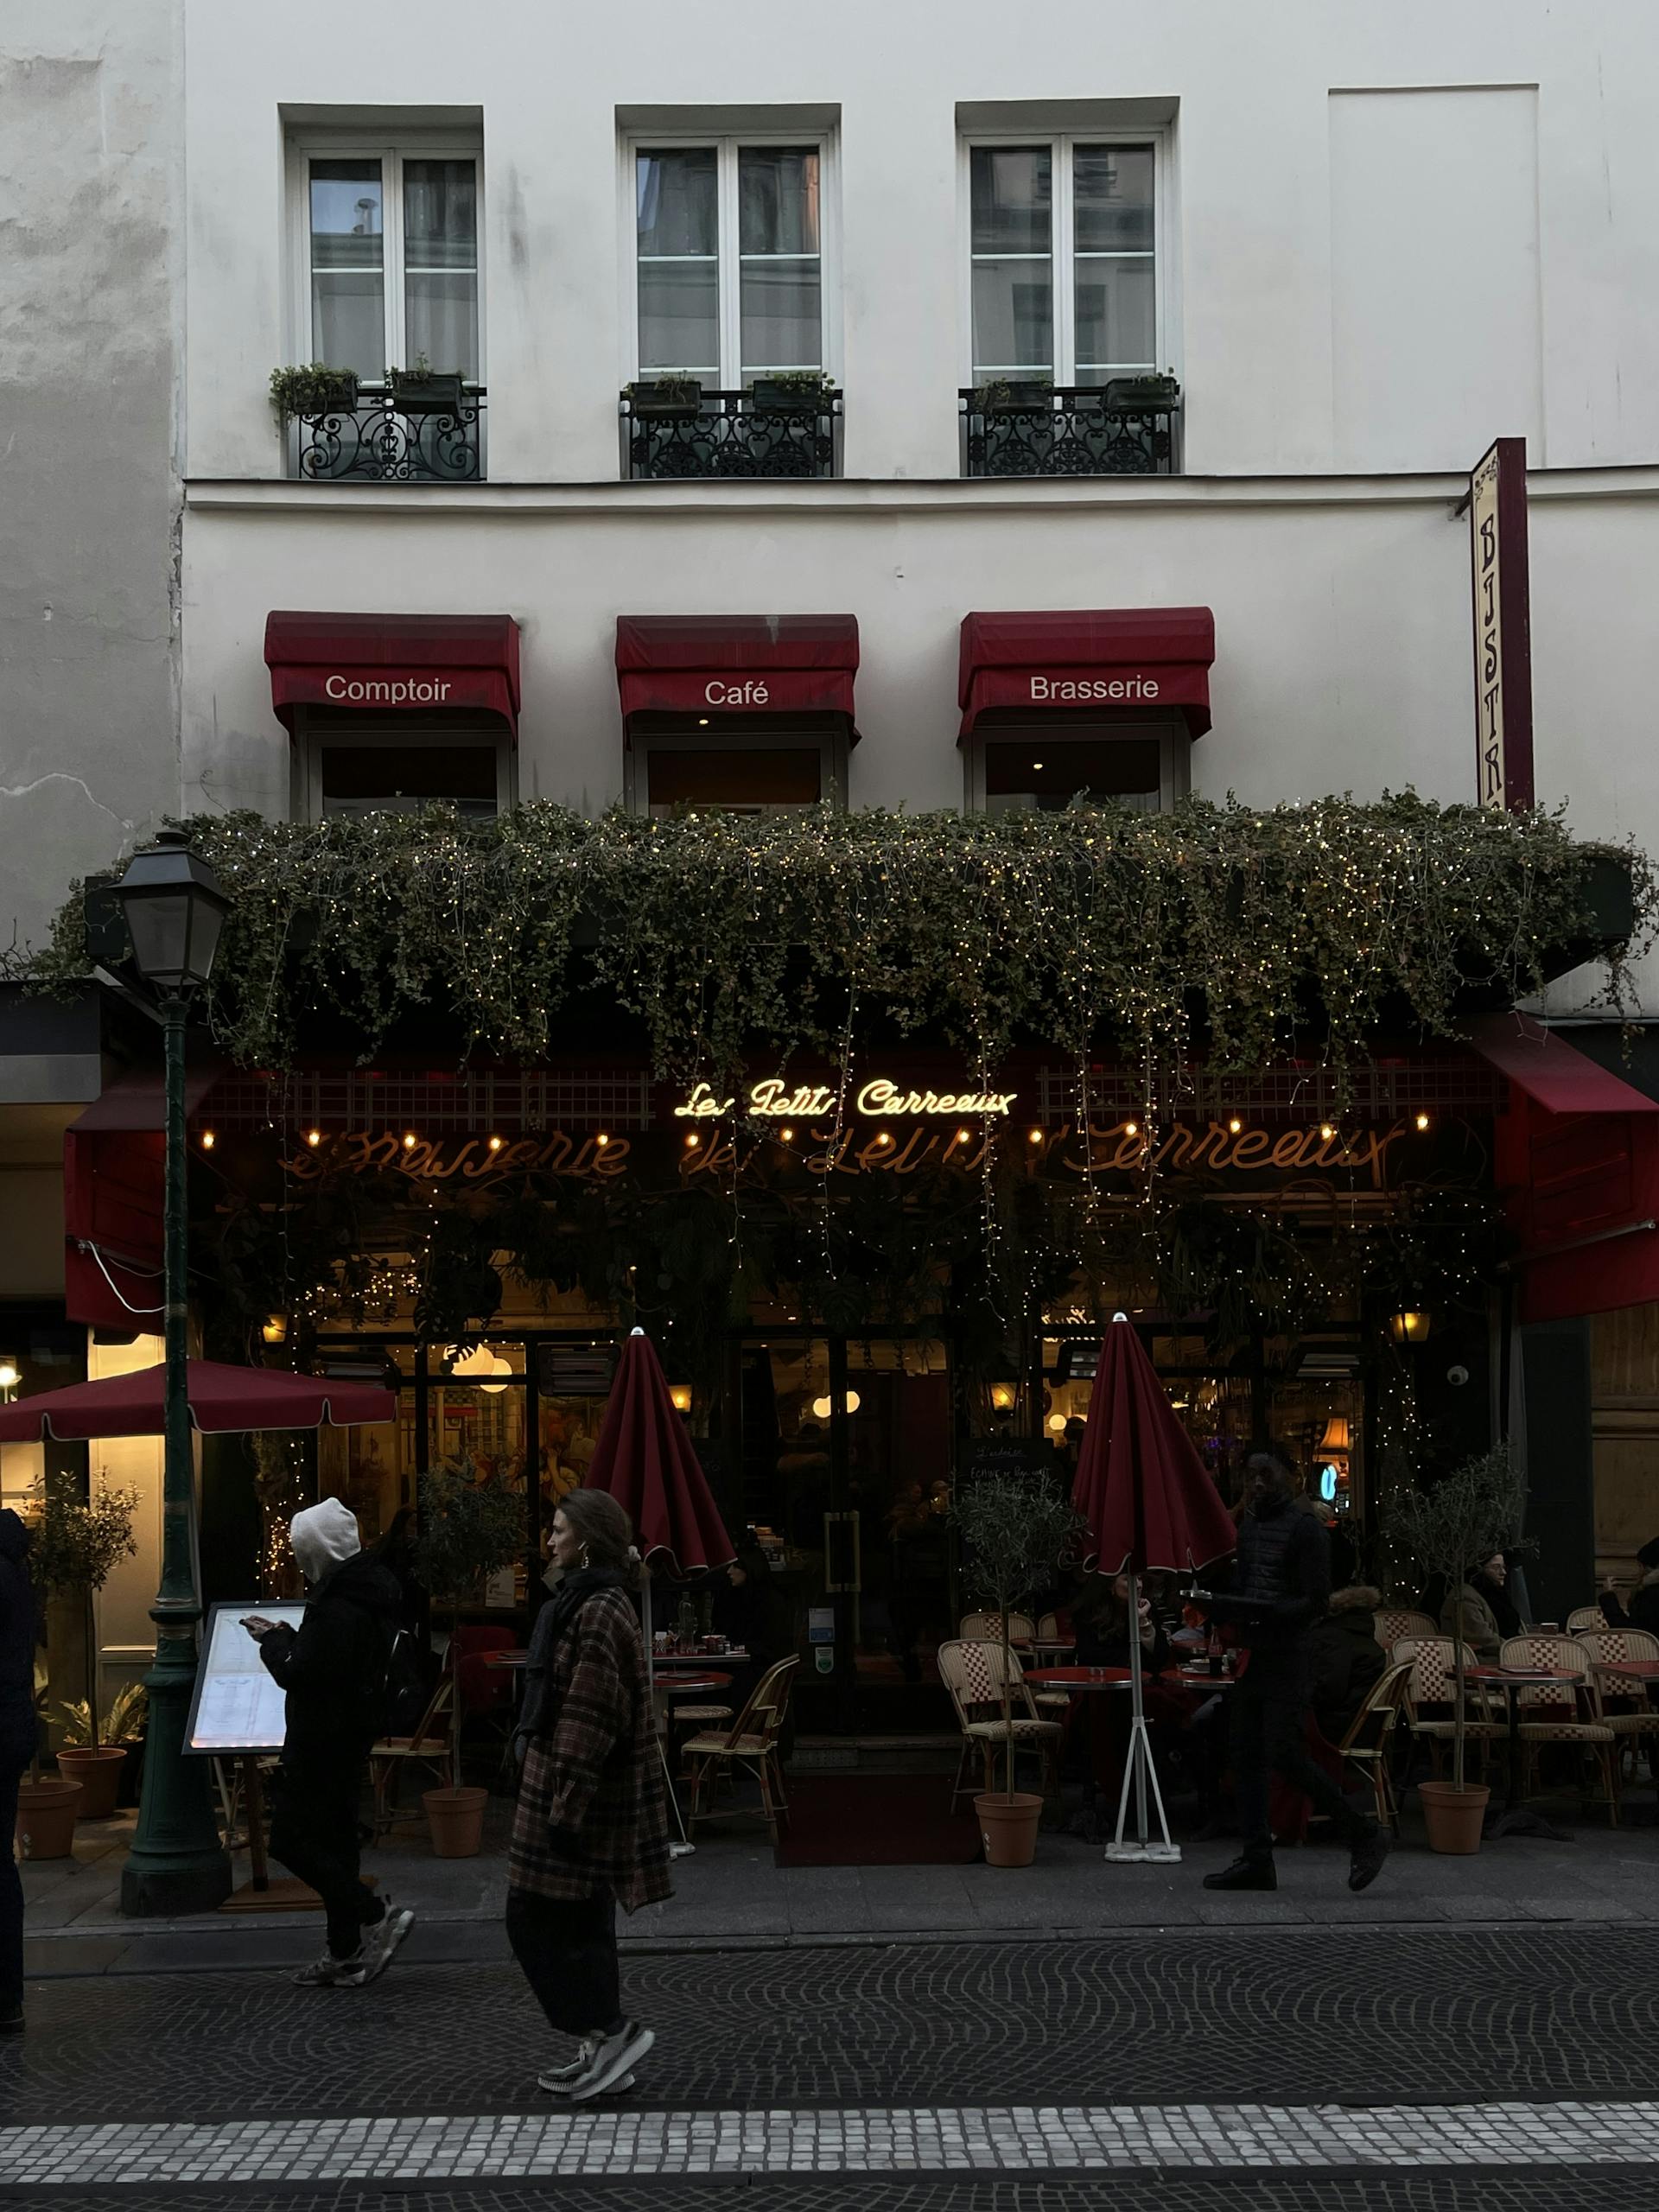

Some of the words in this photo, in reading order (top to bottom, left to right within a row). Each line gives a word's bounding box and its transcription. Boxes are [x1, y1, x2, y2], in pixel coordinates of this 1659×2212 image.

[325, 675, 451, 704] Comptoir
[704, 680, 769, 705] Café
[1030, 674, 1160, 700] Brasserie
[674, 1083, 735, 1117] Les
[749, 1078, 837, 1116] Petits
[857, 1078, 1019, 1116] Carreaux
